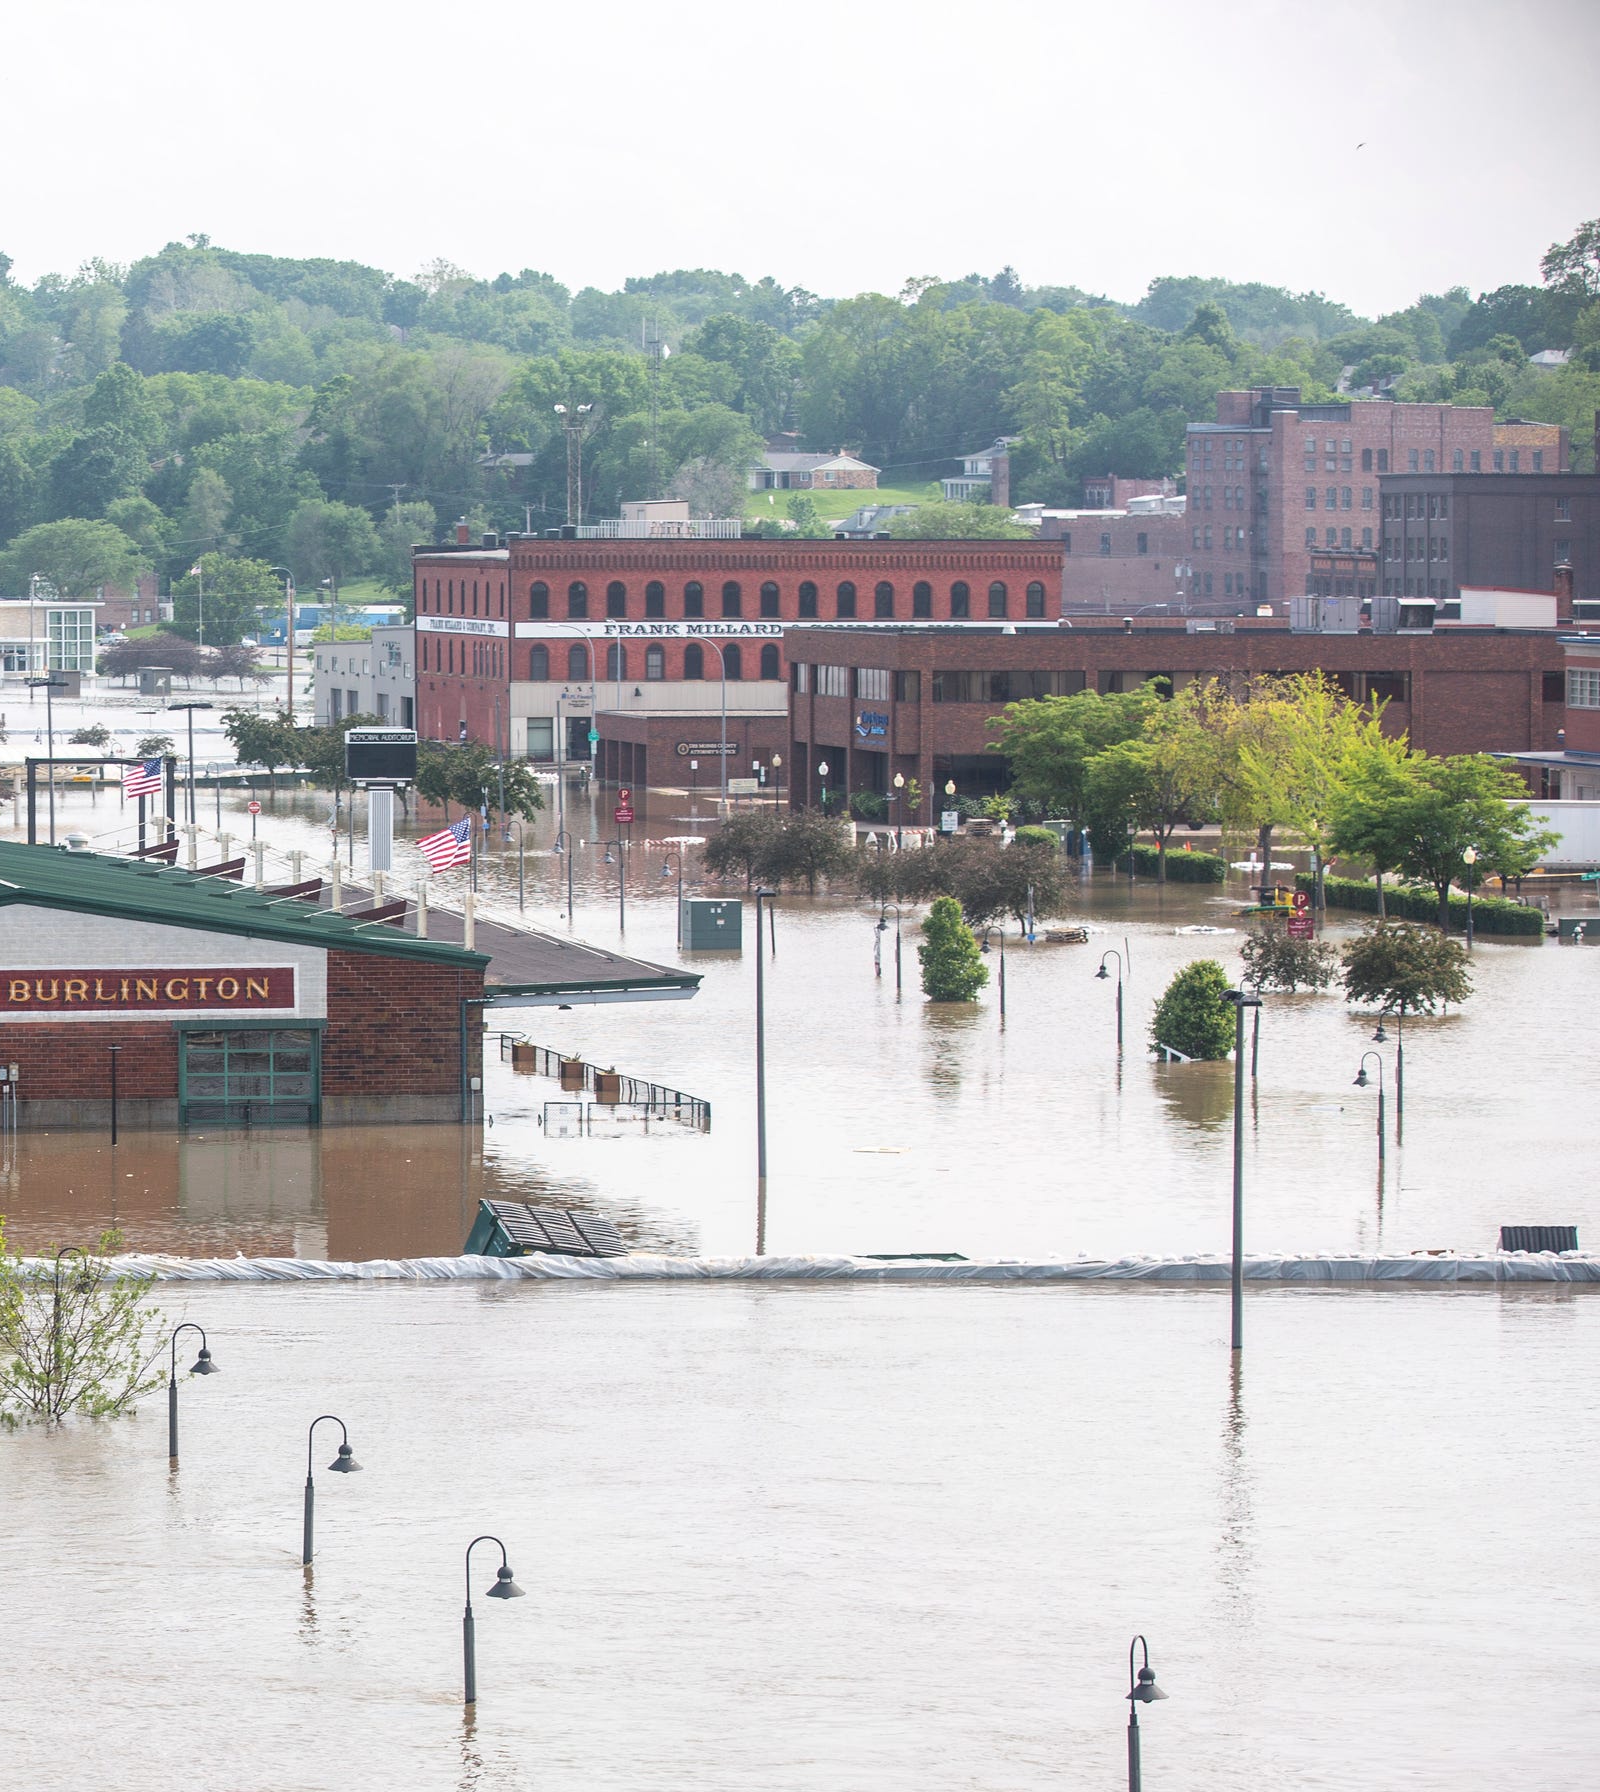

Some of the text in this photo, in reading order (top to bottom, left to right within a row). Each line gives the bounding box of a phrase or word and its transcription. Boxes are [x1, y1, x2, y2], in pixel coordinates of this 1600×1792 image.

[604, 624, 783, 635] FRANK MILLARD
[621, 790, 629, 799] P
[1297, 894, 1306, 906] P
[8, 977, 269, 1002] BURLINGTON
